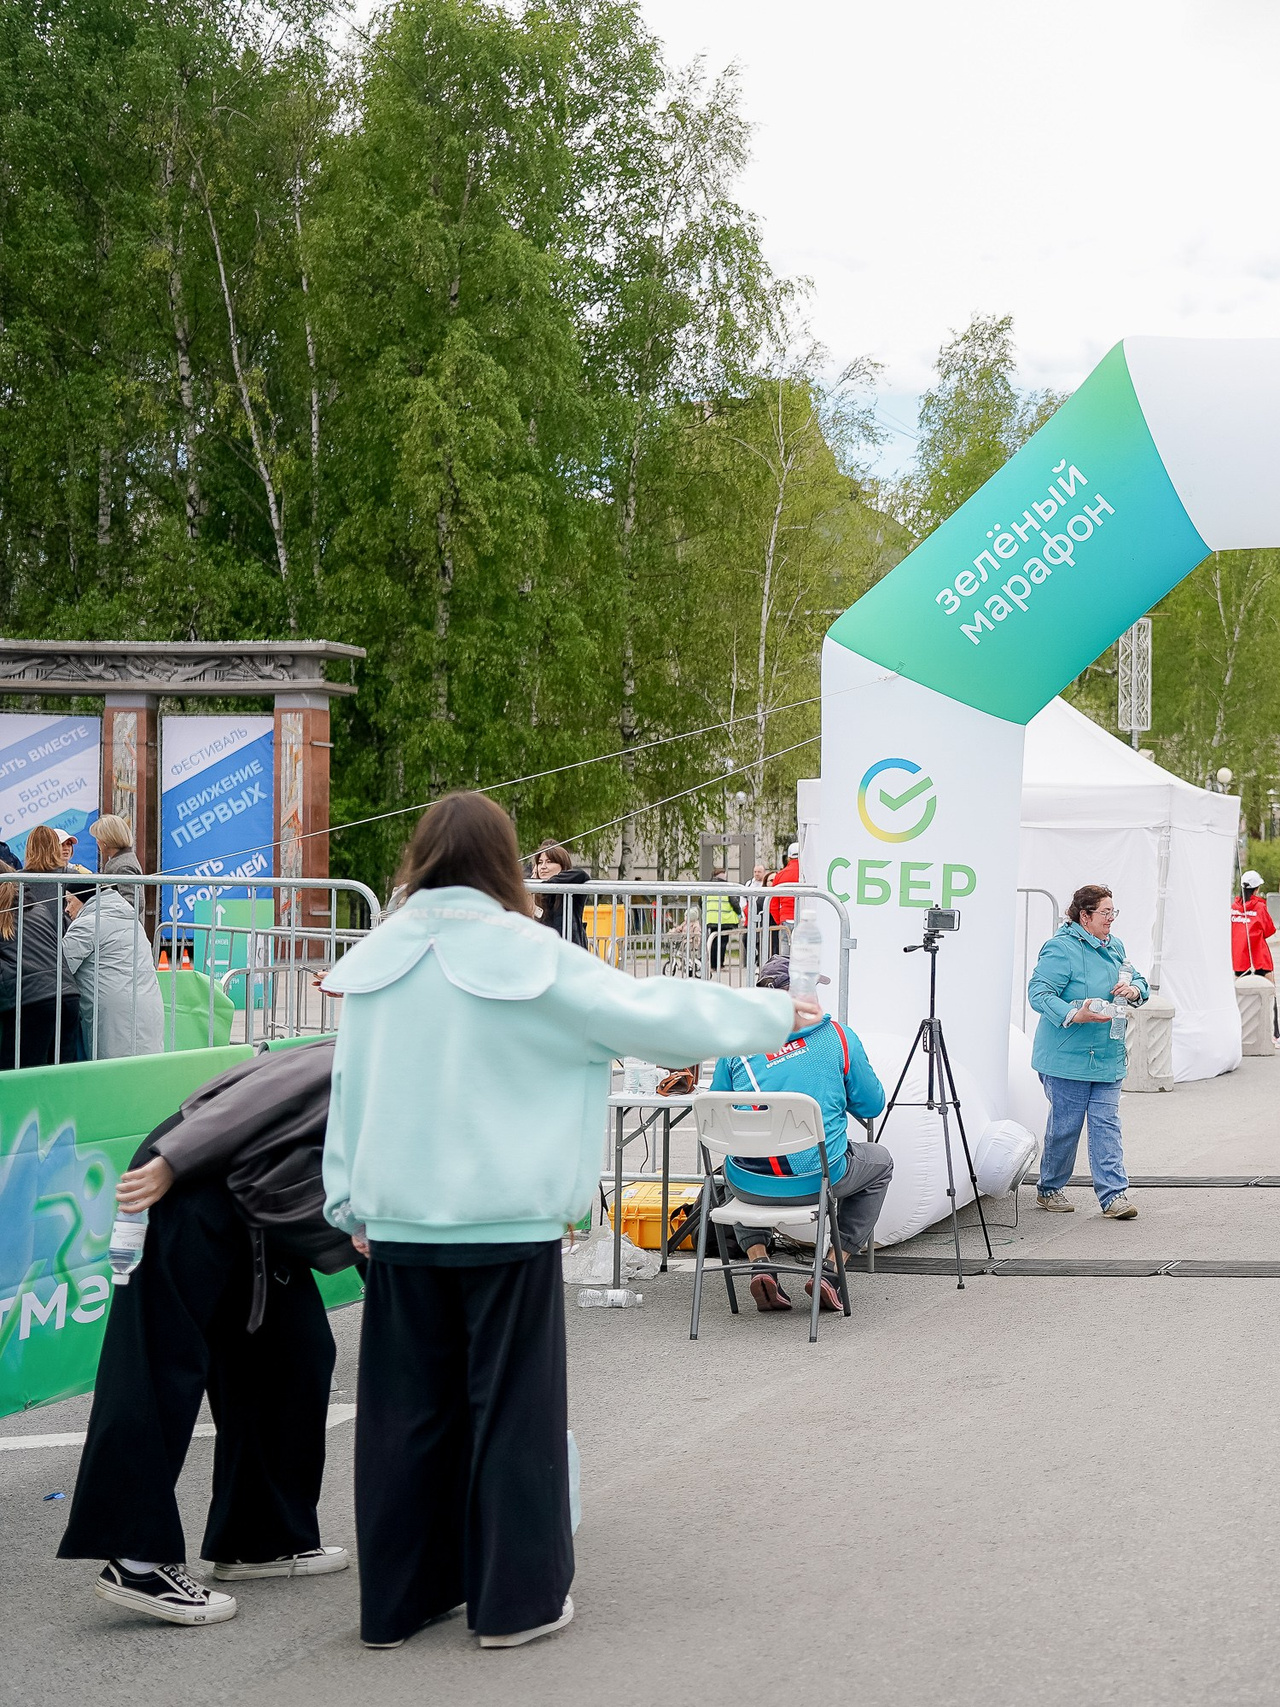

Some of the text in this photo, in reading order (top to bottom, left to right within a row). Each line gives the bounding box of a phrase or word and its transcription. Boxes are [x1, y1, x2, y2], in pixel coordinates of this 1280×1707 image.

[935, 458, 1089, 616] зелёный
[959, 493, 1117, 646] марафон
[27, 724, 90, 763] ВМЕСТЕ
[170, 727, 249, 777] ФЕСТИВАЛЬ
[18, 778, 61, 803] БЫТЬ
[170, 781, 268, 849] ПЕРВЫХ
[176, 759, 264, 821] ДВИЖЕНИЕ
[3, 813, 16, 826] С
[826, 857, 977, 909] СБЕР
